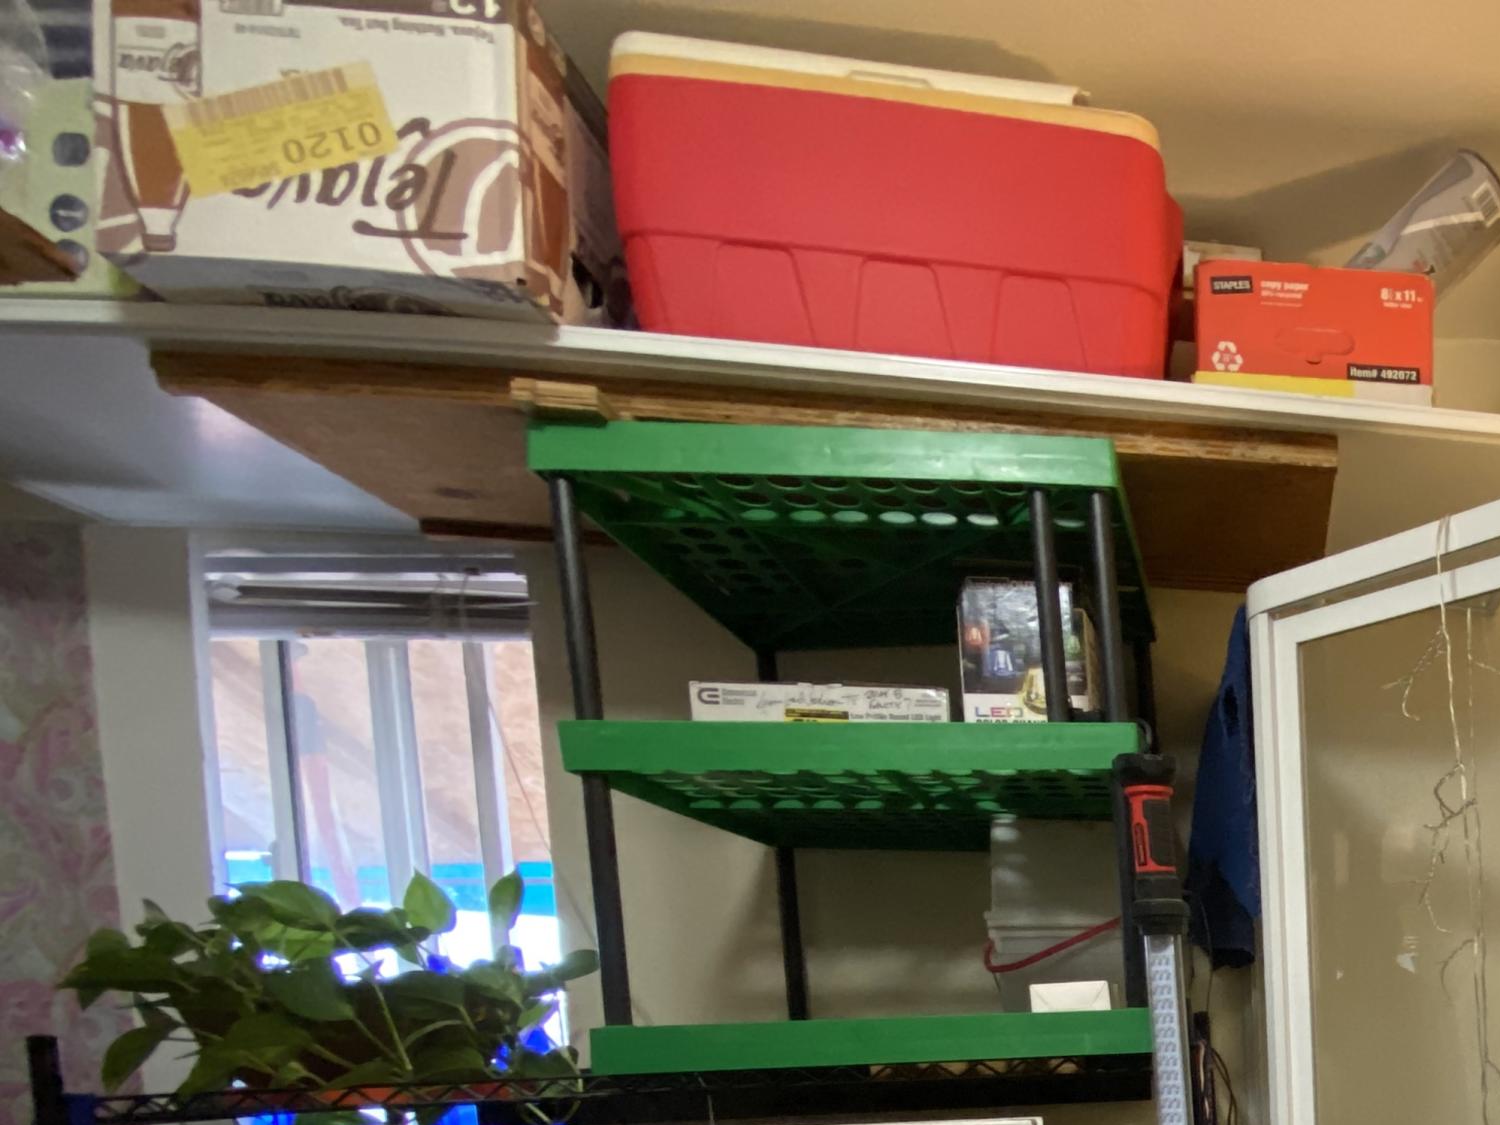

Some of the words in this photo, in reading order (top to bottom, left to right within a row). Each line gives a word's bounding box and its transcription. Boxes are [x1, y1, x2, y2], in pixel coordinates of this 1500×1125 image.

[282, 121, 382, 166] 0120
[1213, 280, 1251, 290] STAPLES
[975, 707, 1024, 718] LED
